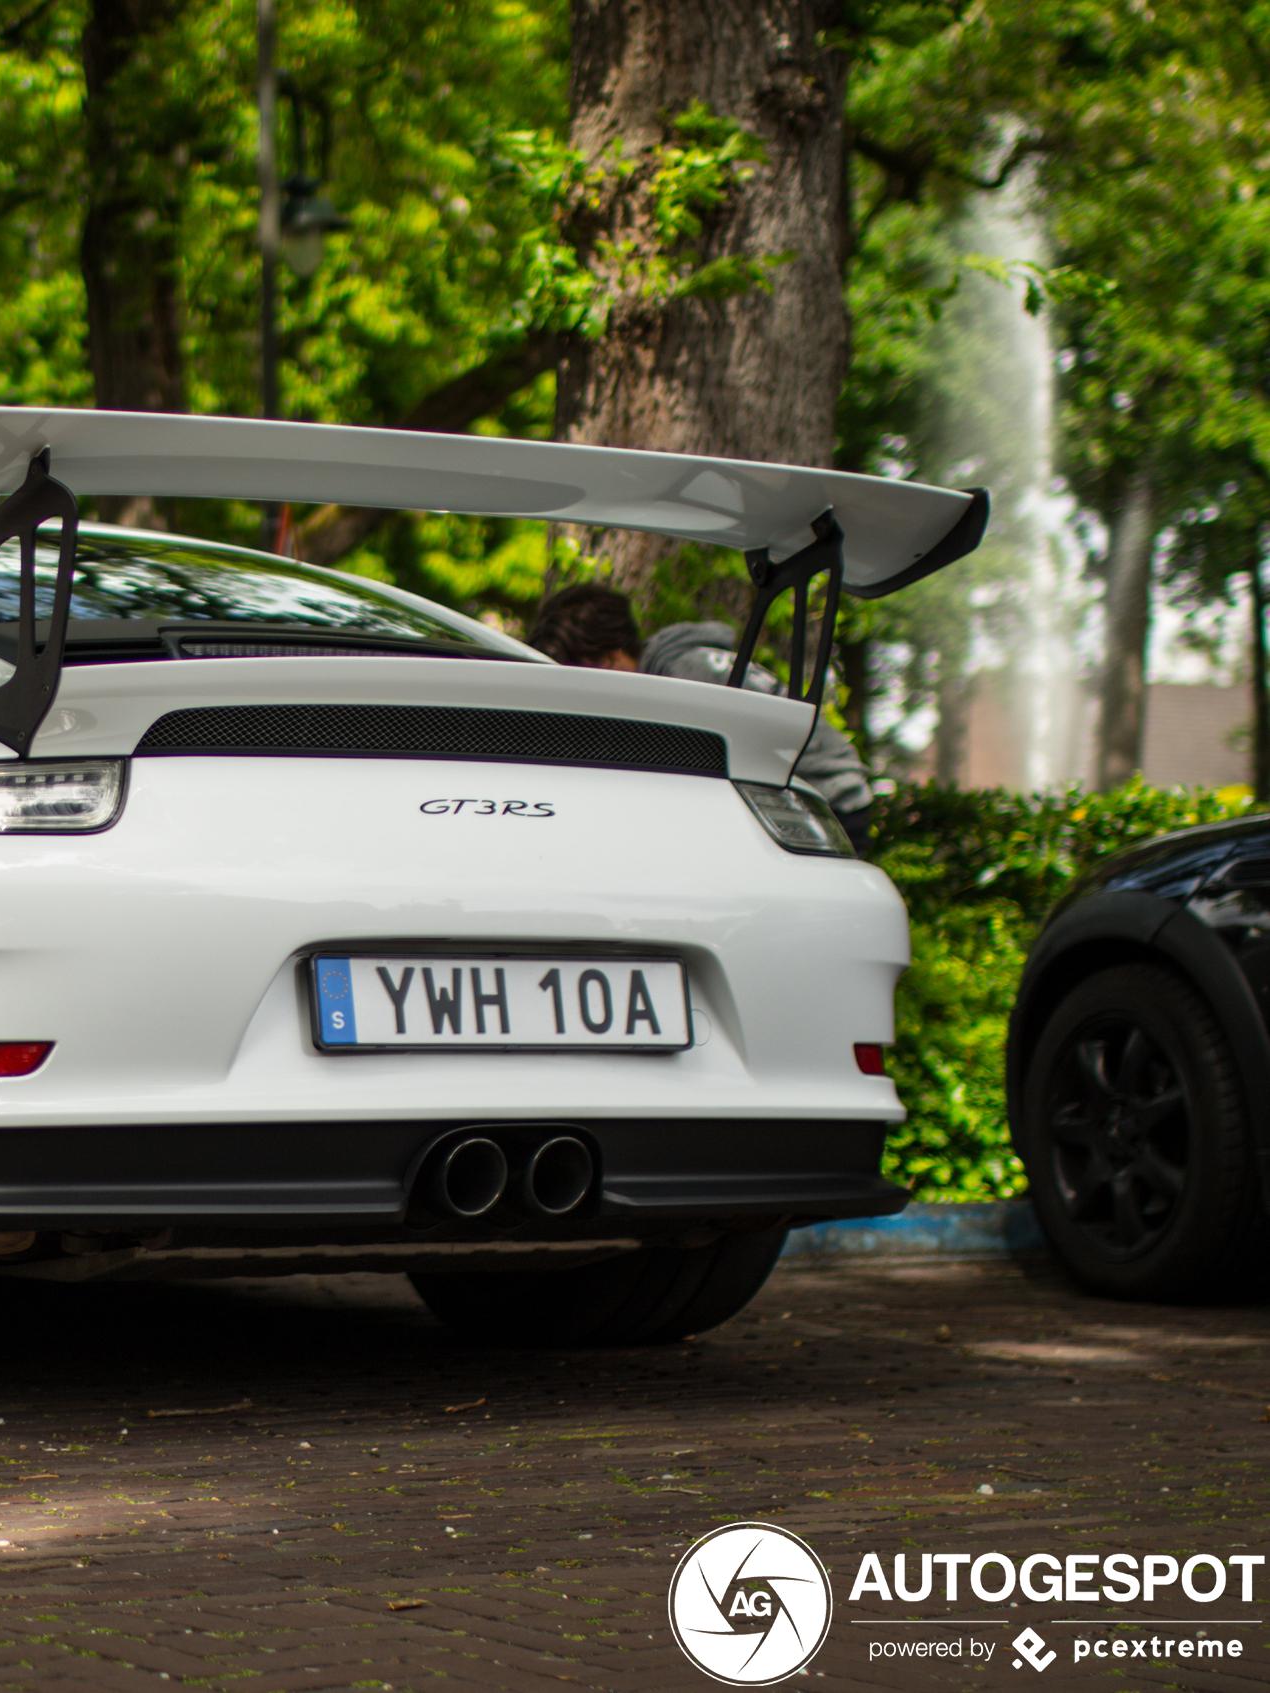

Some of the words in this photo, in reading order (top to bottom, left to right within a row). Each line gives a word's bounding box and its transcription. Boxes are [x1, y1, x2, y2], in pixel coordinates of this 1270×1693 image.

[332, 1010, 345, 1029] S
[377, 966, 510, 1034] YWH
[538, 968, 661, 1036] 10A
